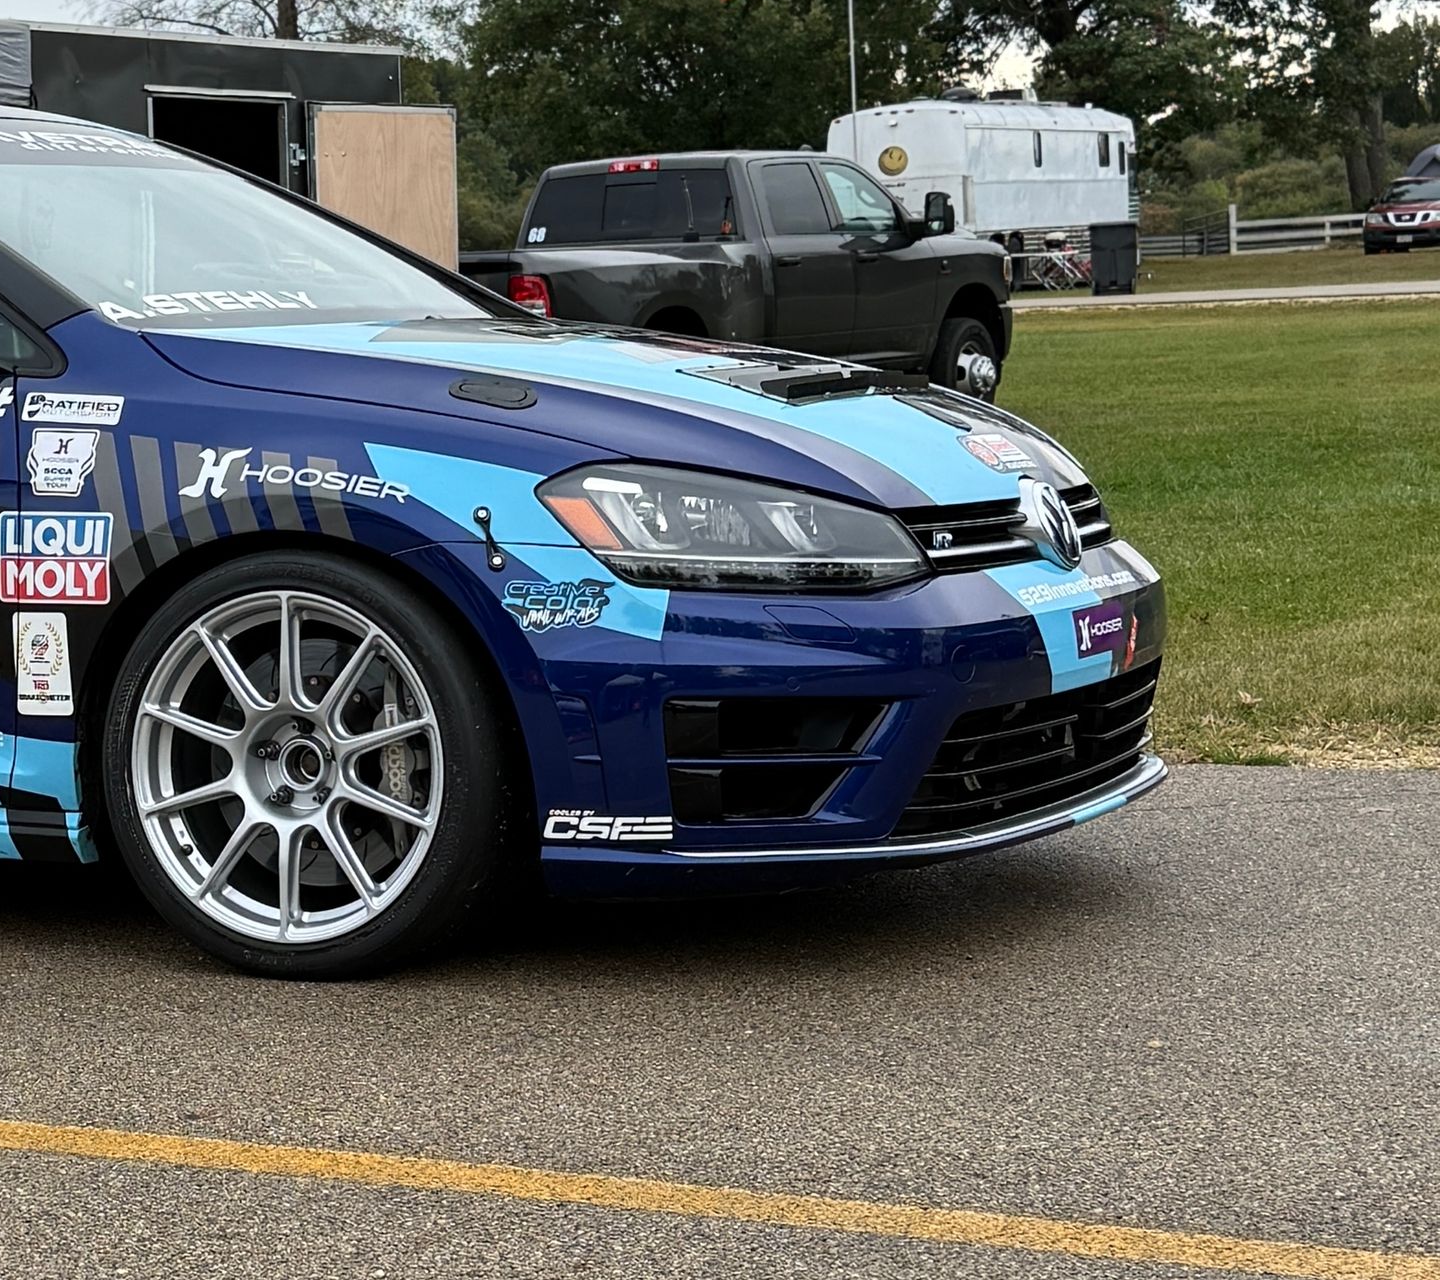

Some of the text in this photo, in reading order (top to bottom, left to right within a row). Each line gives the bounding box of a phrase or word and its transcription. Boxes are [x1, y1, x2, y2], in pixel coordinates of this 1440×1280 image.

[528, 227, 546, 243] 68
[98, 291, 318, 323] A.STEHLY
[239, 463, 410, 504] HOOSIER
[6, 518, 105, 556] LIQUI
[6, 560, 106, 598] MOLY
[509, 582, 600, 596] creative
[525, 594, 607, 610] color
